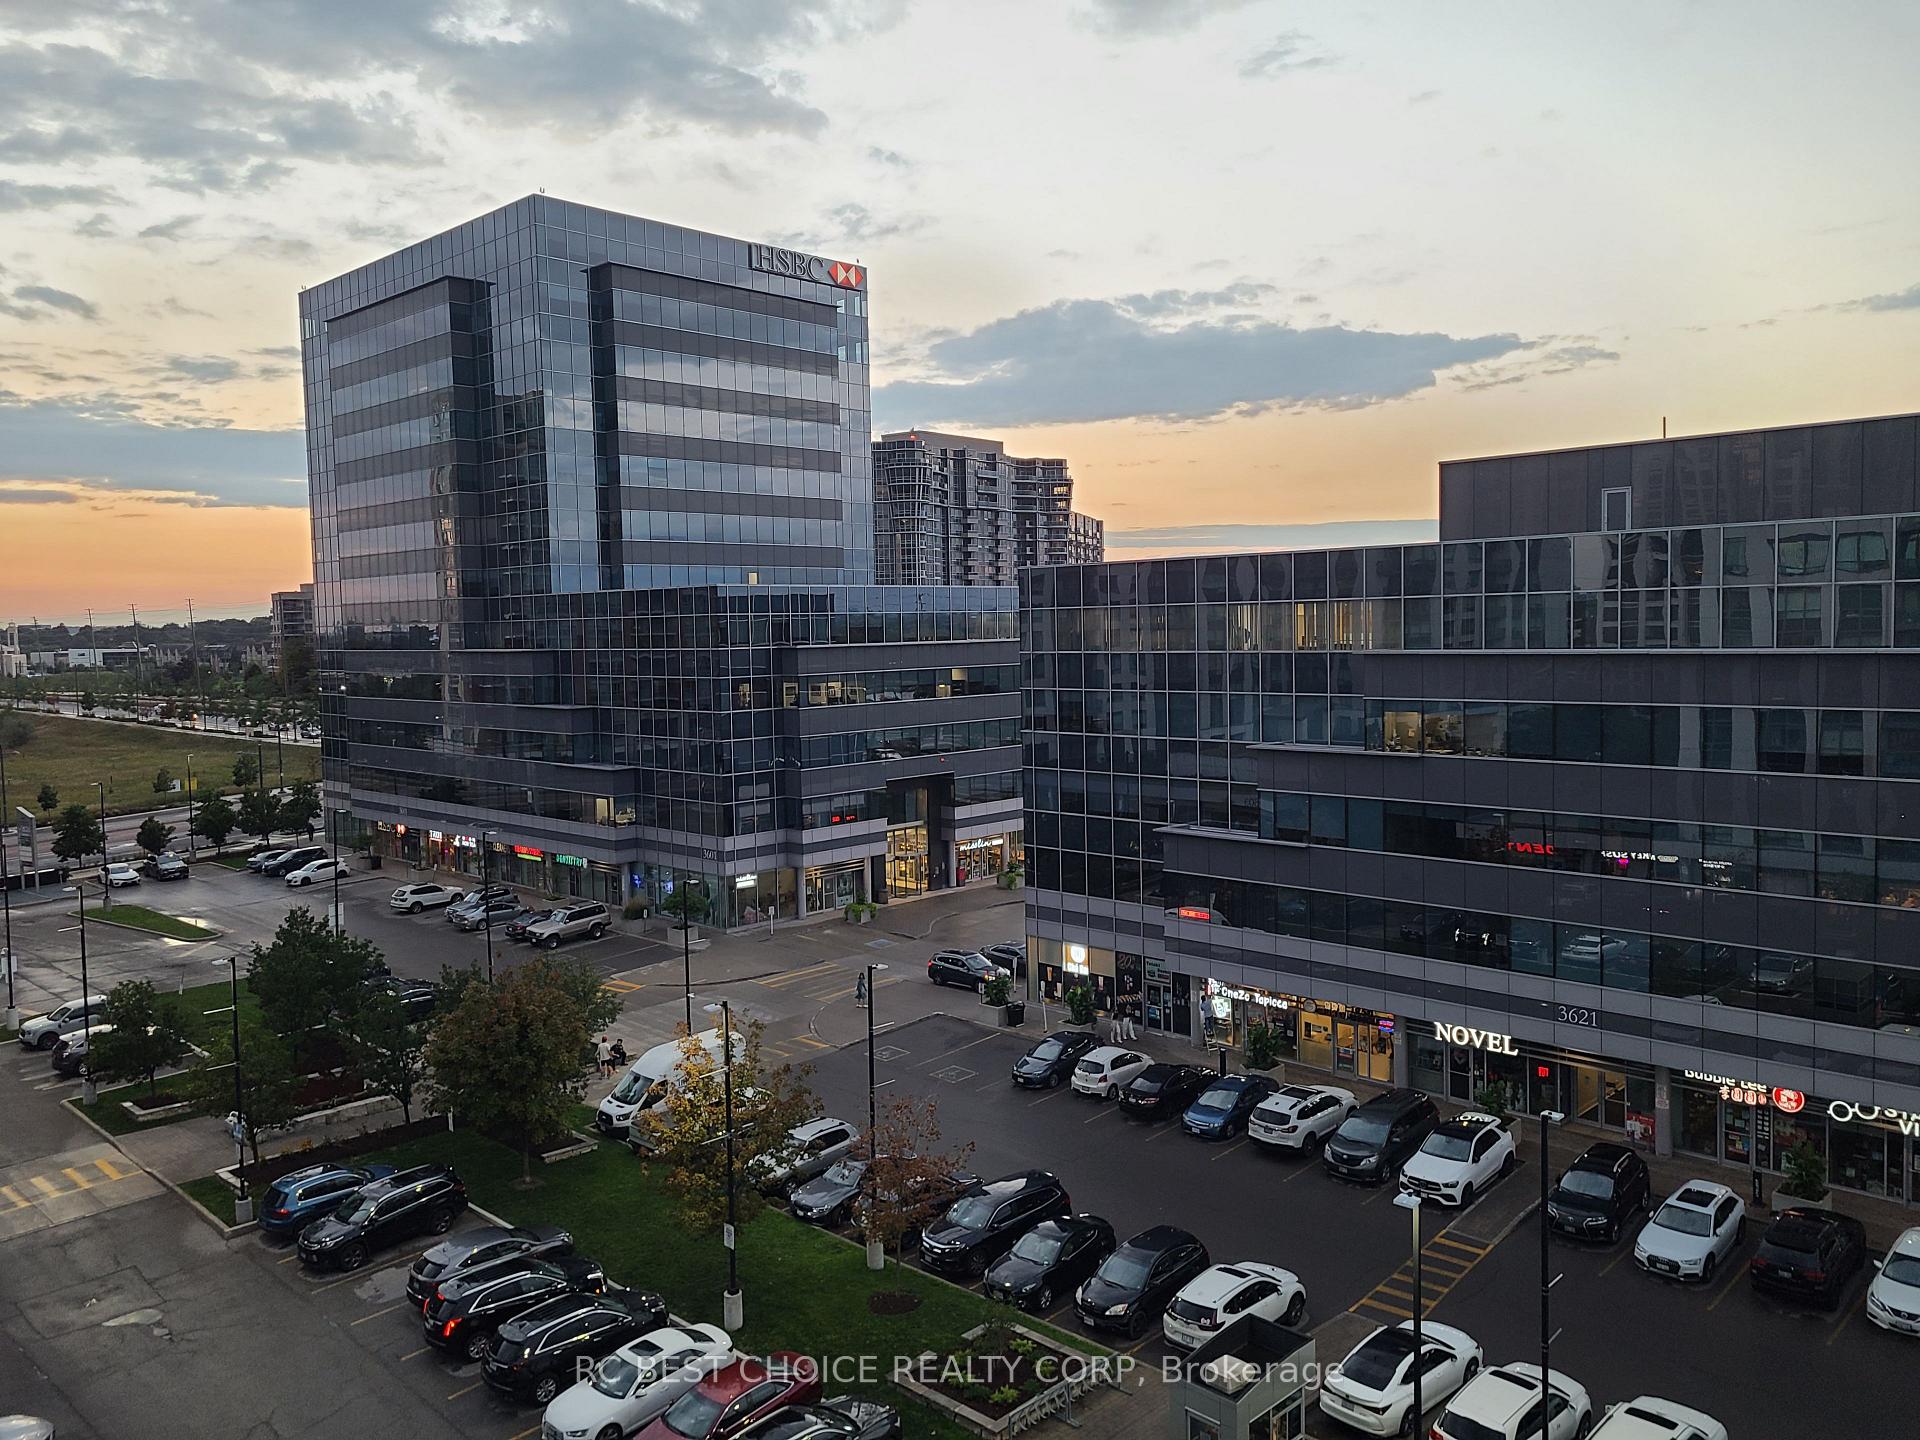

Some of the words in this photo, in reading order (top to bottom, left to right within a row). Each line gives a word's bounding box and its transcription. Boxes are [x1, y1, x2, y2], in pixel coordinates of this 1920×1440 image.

[754, 243, 824, 281] HSBC
[703, 849, 717, 860] 3601
[1557, 1005, 1598, 1027] 3621
[1433, 1021, 1519, 1056] NOVEL
